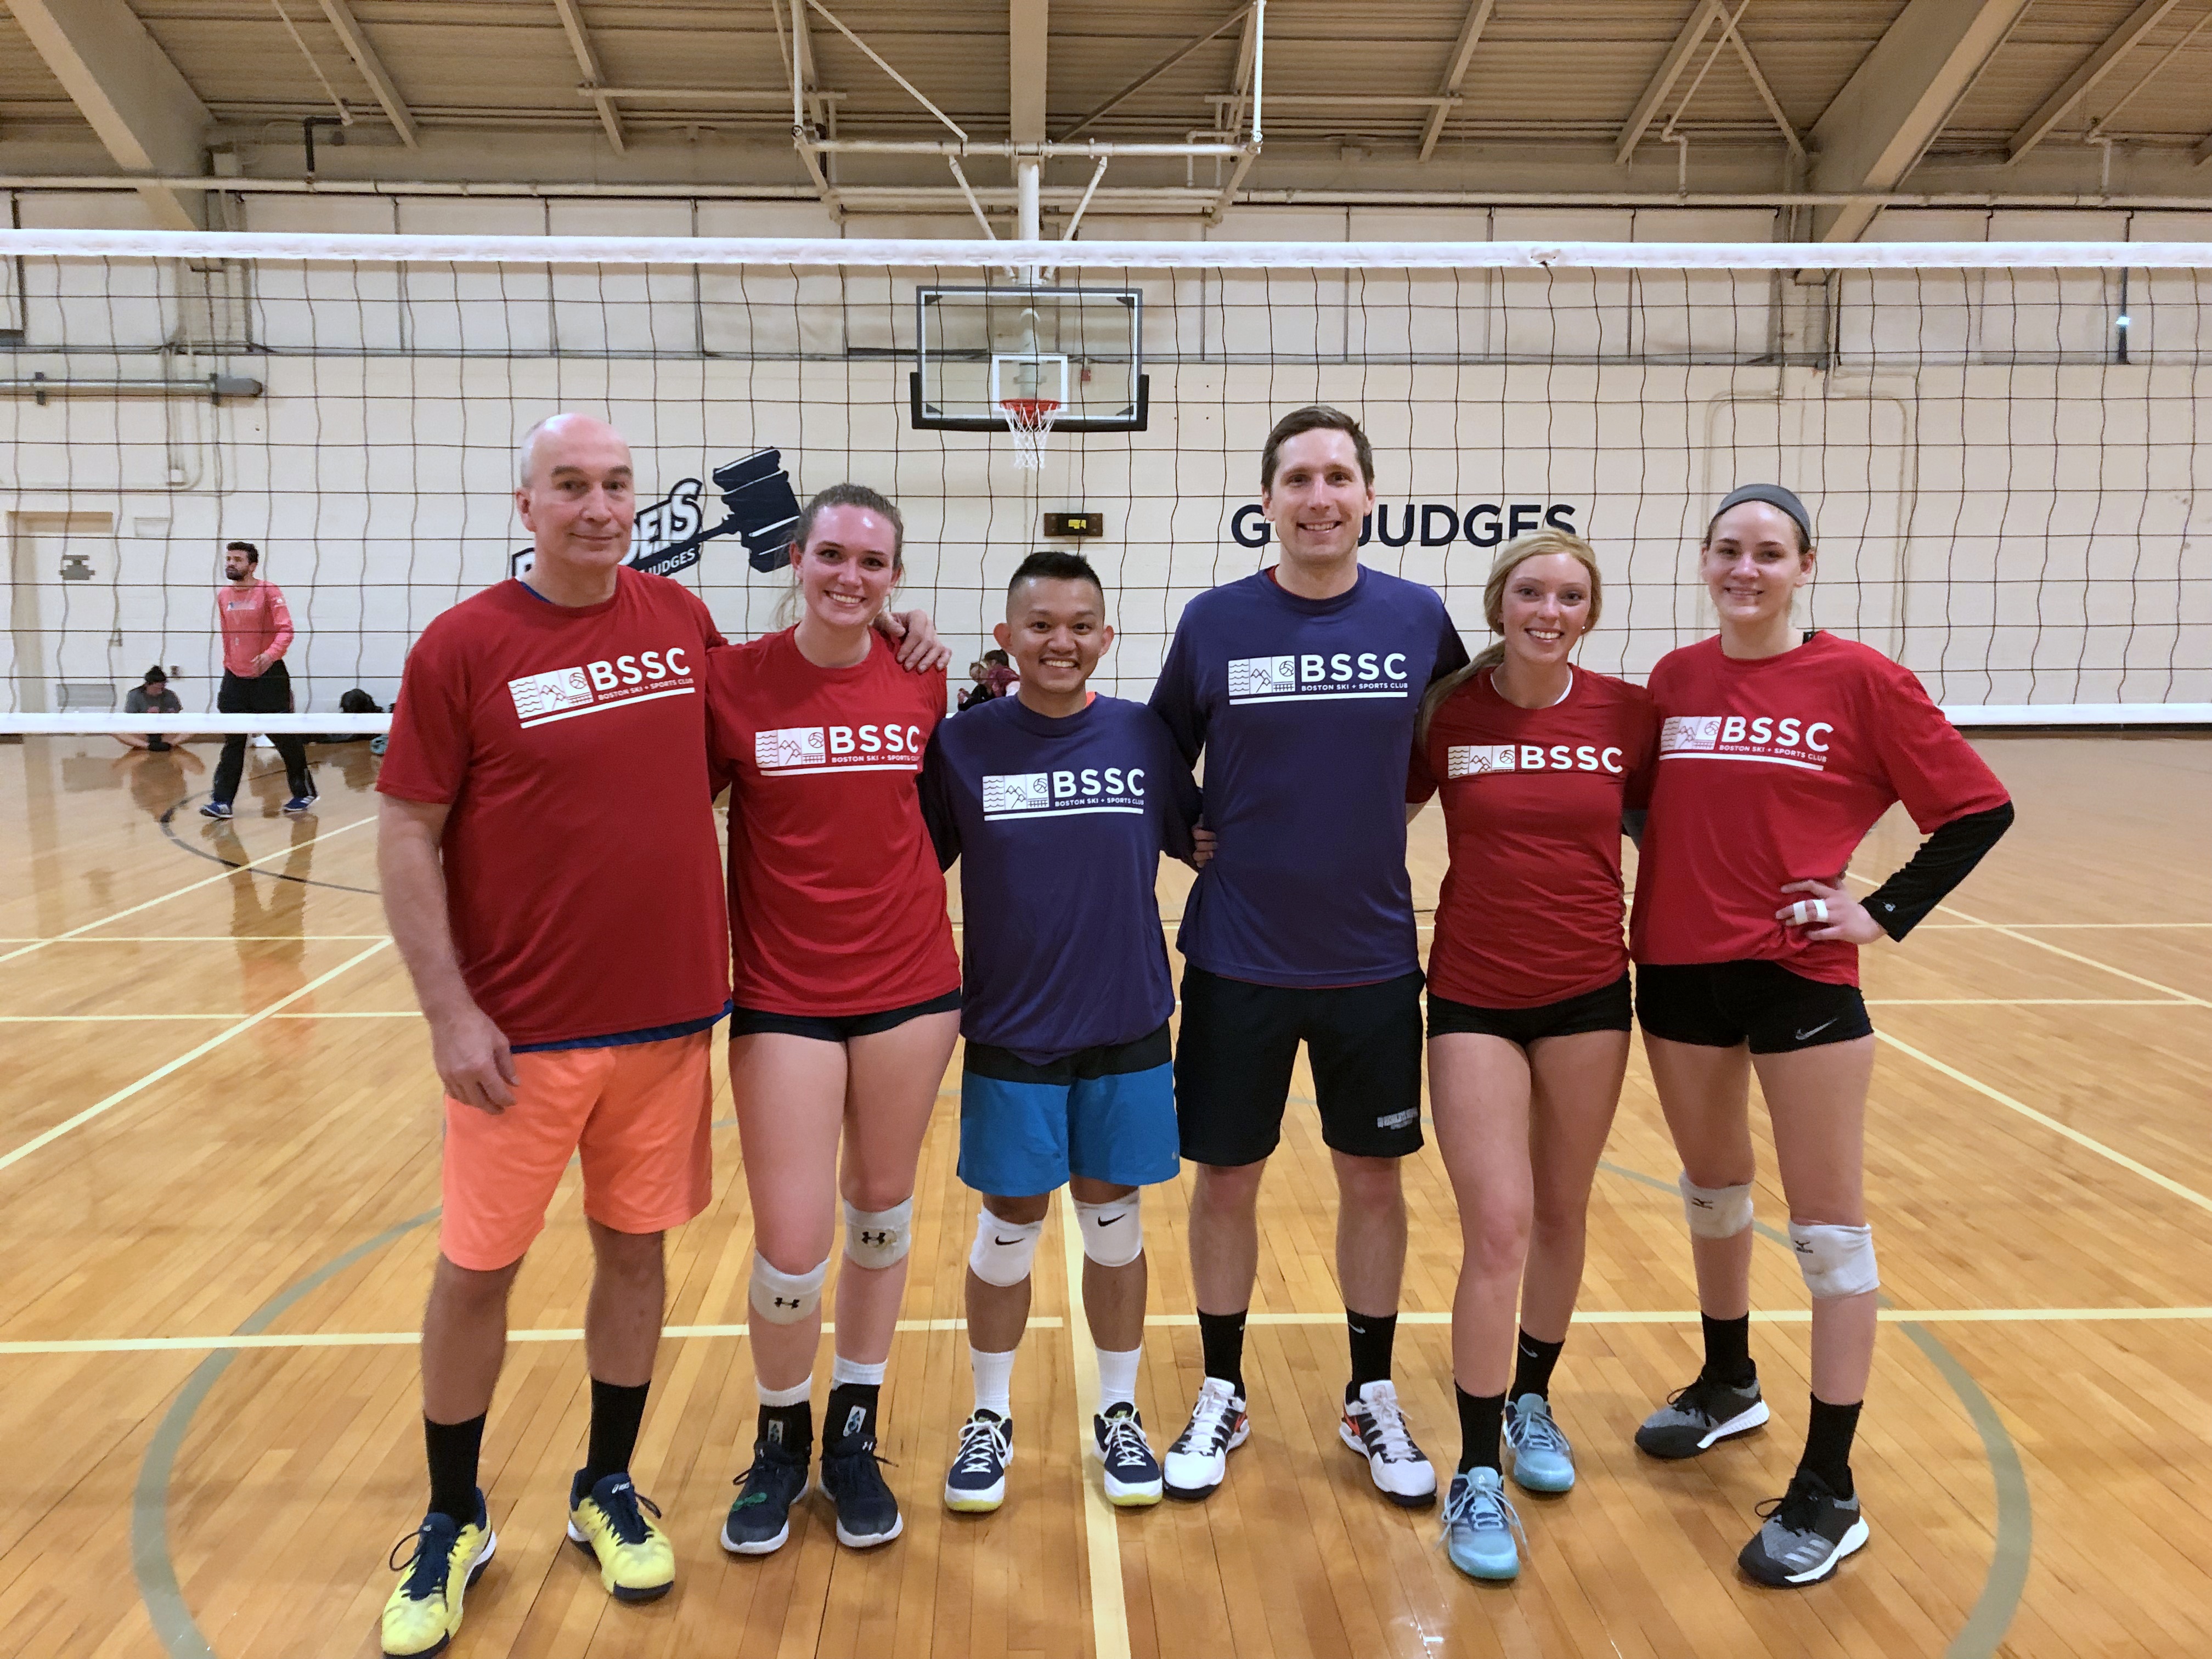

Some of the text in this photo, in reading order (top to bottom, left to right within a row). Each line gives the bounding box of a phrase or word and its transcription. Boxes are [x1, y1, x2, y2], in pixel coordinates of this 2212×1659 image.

[1232, 504, 1271, 548] G
[586, 647, 691, 691] BSSC
[1301, 653, 1408, 682] BSSC
[598, 689, 629, 700] BOSTON
[650, 680, 677, 689] SPORTS
[829, 724, 921, 754] BSSC
[1721, 716, 1834, 752] BSSC
[1521, 744, 1623, 773] BSSC
[1774, 748, 1806, 758] SPORTS
[1808, 753, 1827, 763] CLUB
[1053, 768, 1145, 798] BSSC
